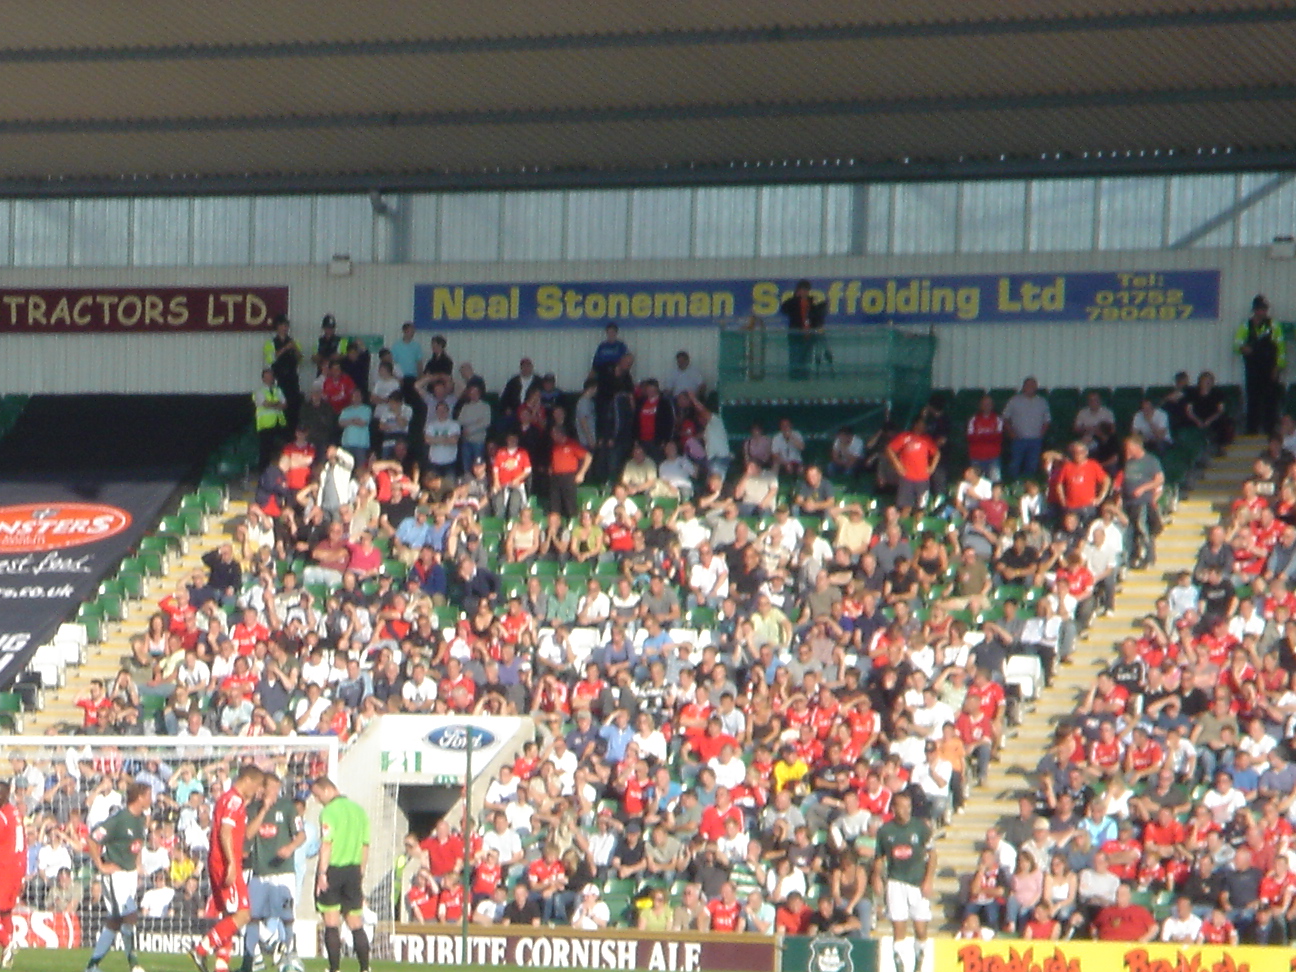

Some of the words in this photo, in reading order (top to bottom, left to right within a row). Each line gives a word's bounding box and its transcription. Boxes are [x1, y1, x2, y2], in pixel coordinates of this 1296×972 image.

[206, 294, 273, 326] LTD.
[432, 286, 520, 320] Neal
[536, 285, 735, 320] Stoneman
[752, 280, 981, 321] Sffolding
[1001, 277, 1067, 313] Ltd
[391, 935, 506, 965] TRIBUTE
[515, 938, 637, 969] CORNISH
[649, 943, 701, 971] ALE
